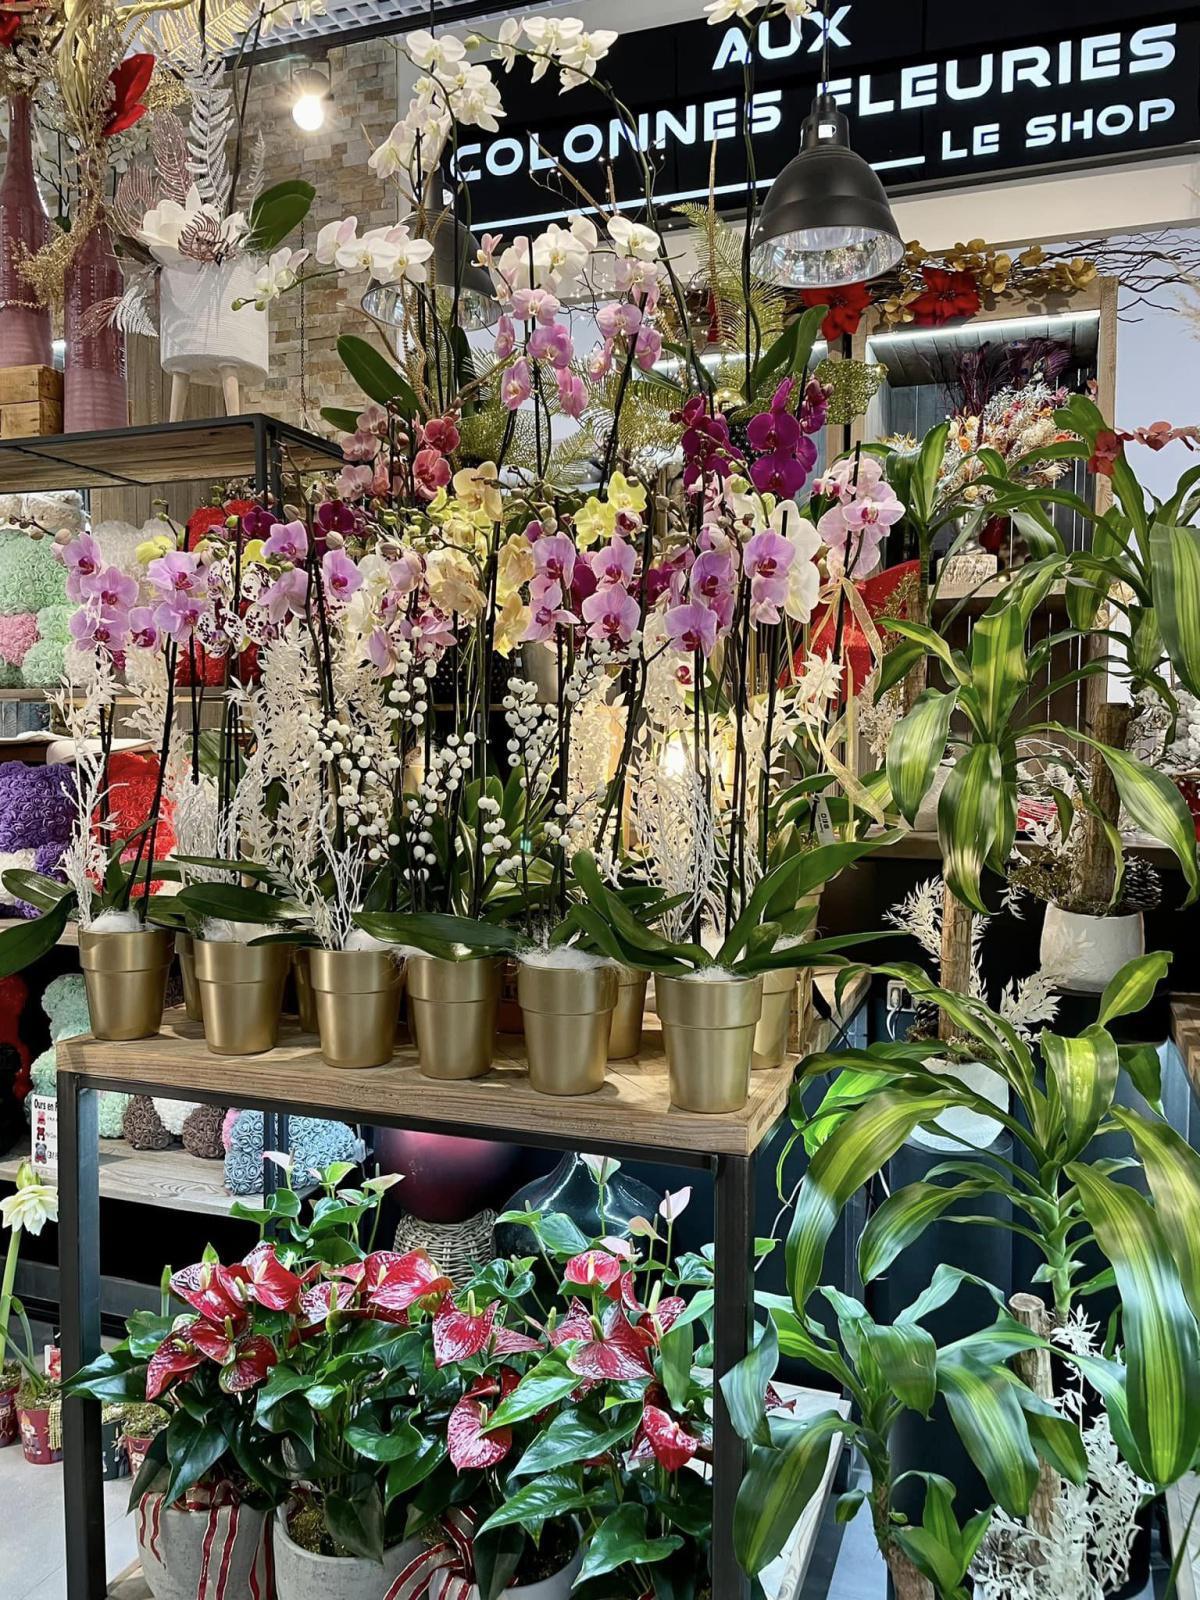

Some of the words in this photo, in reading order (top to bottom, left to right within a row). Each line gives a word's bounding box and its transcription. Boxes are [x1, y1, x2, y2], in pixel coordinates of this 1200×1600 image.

[712, 5, 851, 70] AUX
[450, 90, 782, 182] COLONNES
[816, 23, 1176, 116] FLEURIES
[942, 123, 999, 160] LE
[1025, 98, 1175, 148] SHOP
[34, 1098, 46, 1110] Ours
